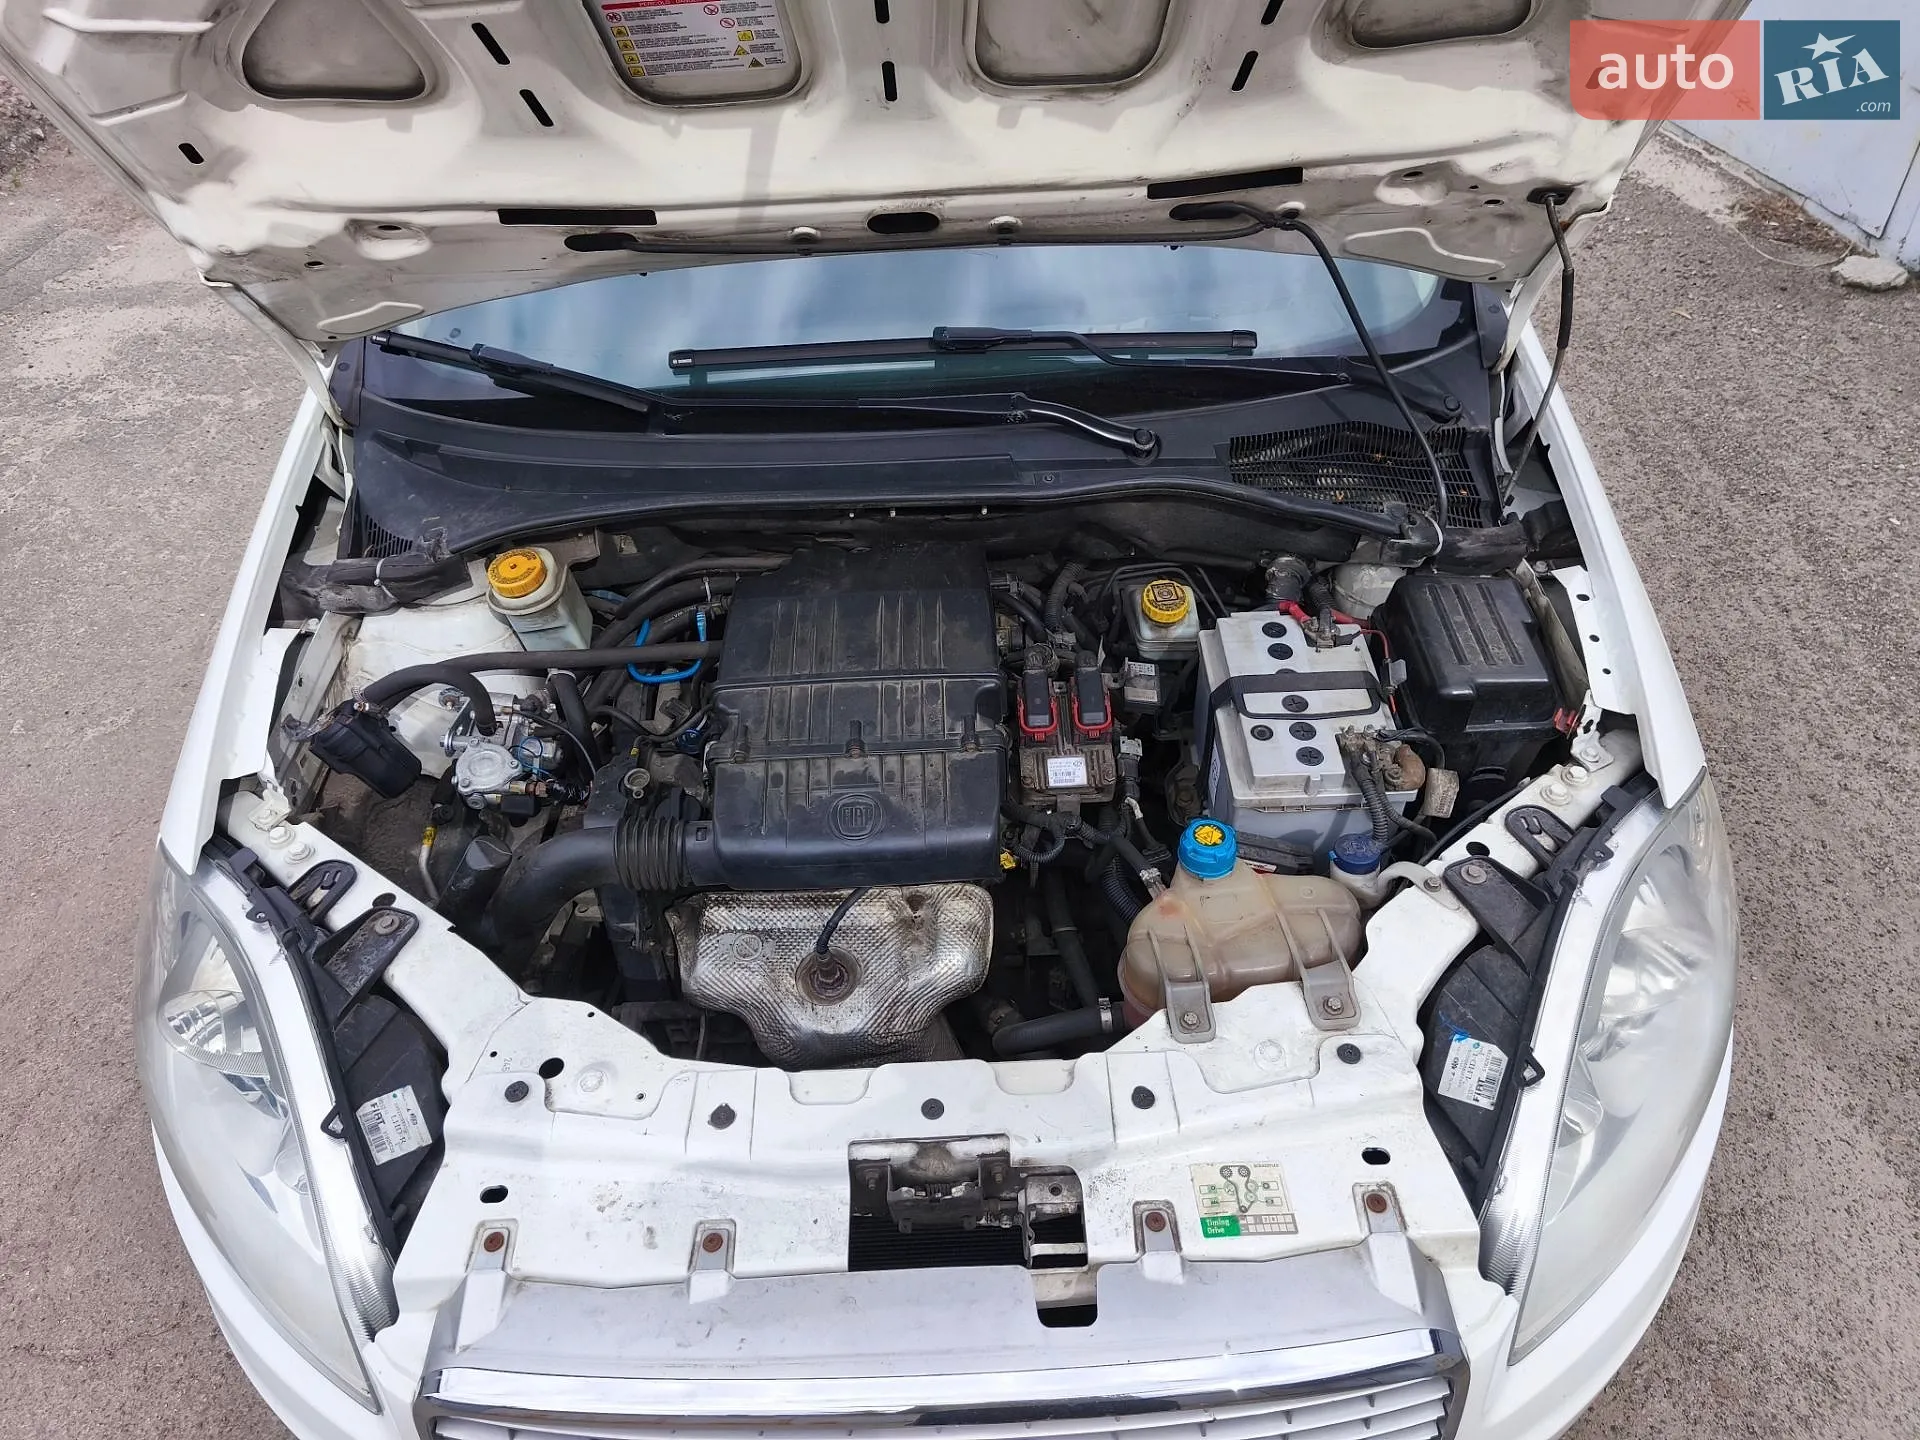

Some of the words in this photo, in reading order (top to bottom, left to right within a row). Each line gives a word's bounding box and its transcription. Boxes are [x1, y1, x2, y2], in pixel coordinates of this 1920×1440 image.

[842, 806, 873, 828] FIAT
[1472, 1077, 1485, 1102] FIAT
[370, 1102, 386, 1125] FIAT
[1207, 1219, 1230, 1227] Timing
